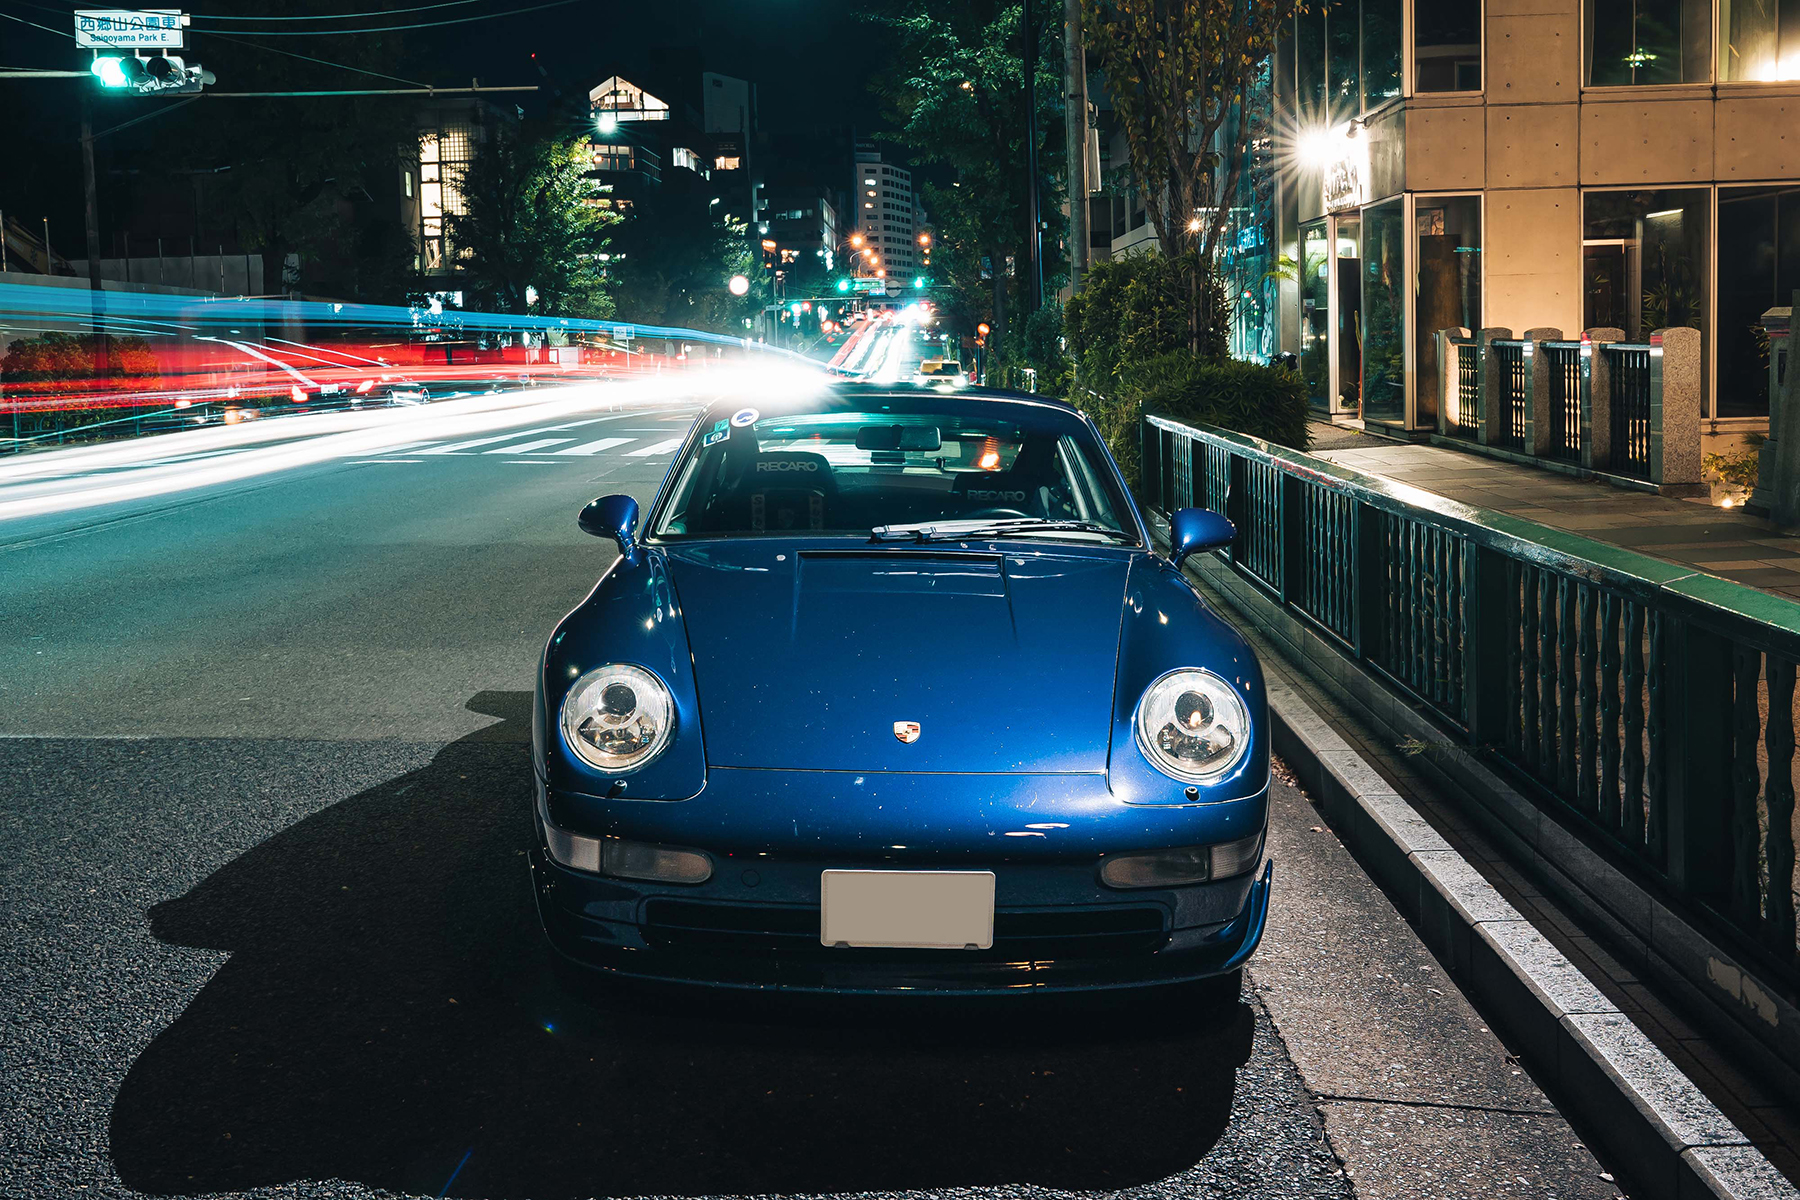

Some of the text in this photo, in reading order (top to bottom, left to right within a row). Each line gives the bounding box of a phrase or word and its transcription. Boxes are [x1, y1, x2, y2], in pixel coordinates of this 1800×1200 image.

[80, 16, 176, 31] 西郷山公園東
[90, 33, 170, 43] Saigoyama Park E.
[756, 461, 819, 472] RECARO
[967, 489, 1026, 502] RECARO
